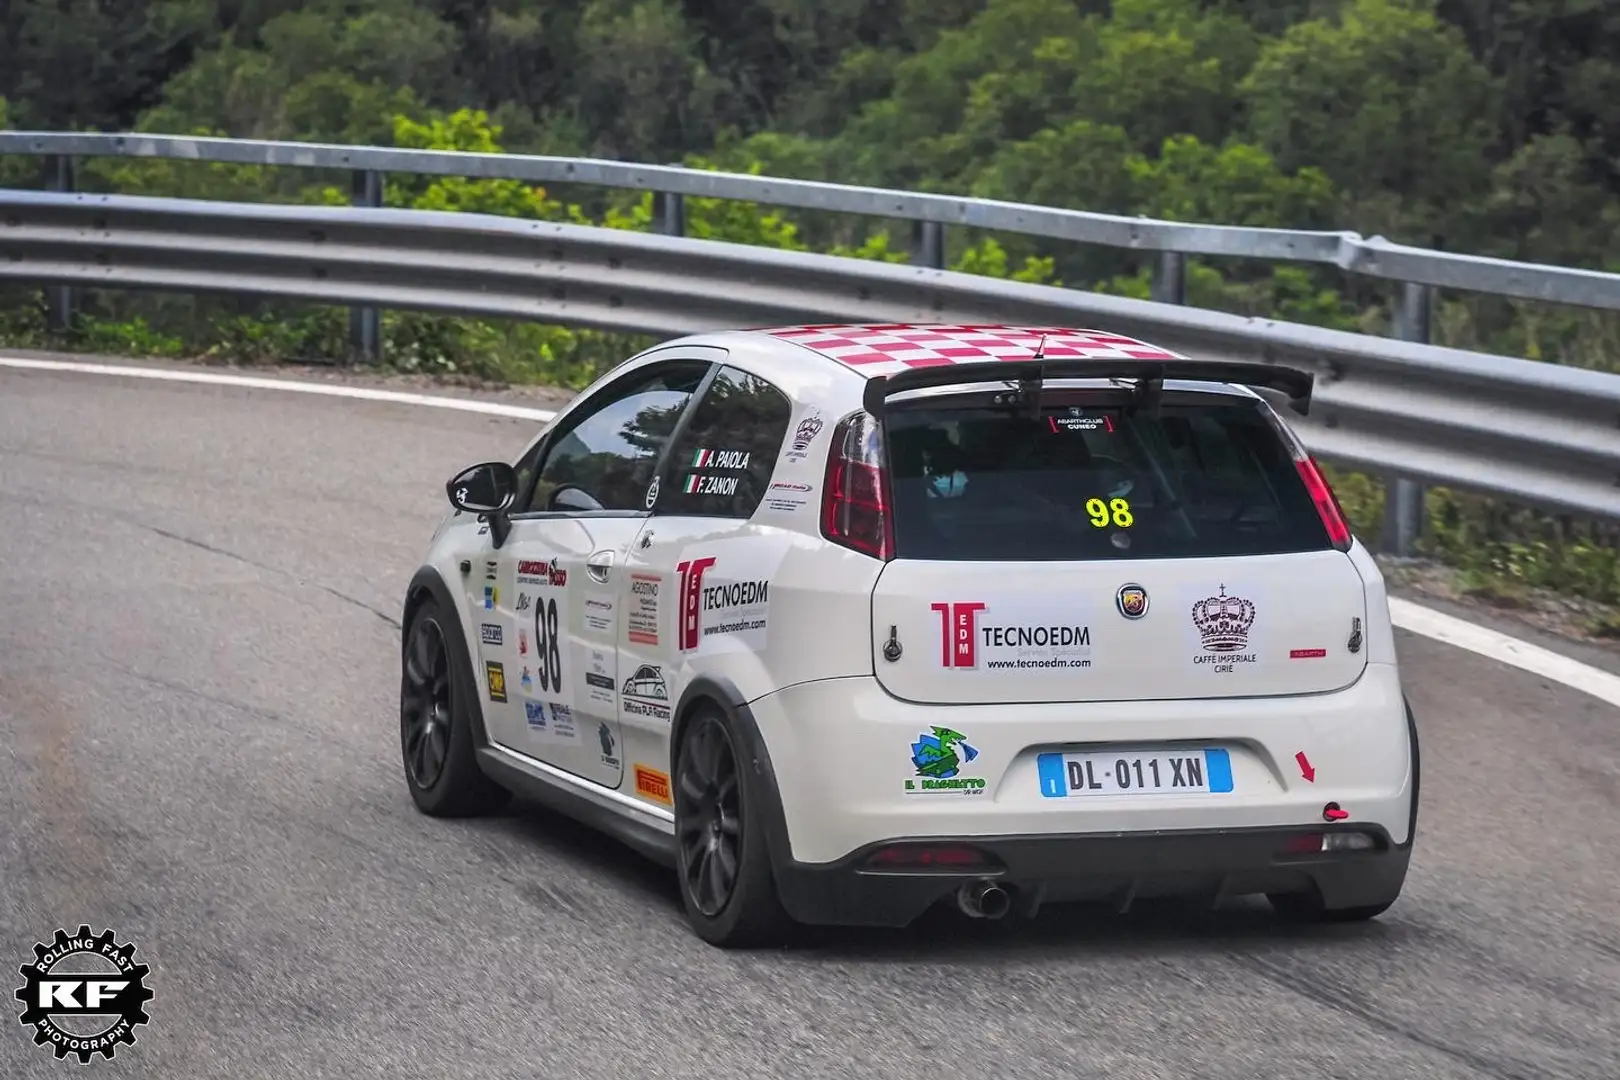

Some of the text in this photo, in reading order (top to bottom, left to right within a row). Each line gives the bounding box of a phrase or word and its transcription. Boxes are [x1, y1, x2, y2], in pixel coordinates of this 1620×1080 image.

[705, 450, 751, 469] A. PAIOLA
[696, 476, 739, 496] F. ZANON
[1085, 498, 1134, 527] 98
[703, 580, 769, 611] TECNOEDM
[704, 618, 767, 636] www.tecnoedm.com
[959, 614, 969, 656] EDM
[982, 626, 1091, 647] TECNOEDM
[535, 597, 562, 694] 98
[987, 657, 1092, 669] www.tecnoedm.com
[1218, 654, 1257, 664] IMPERIALE
[1067, 758, 1204, 790] DL 011 XN
[638, 771, 669, 799] PIRELLI
[905, 780, 915, 790] IL
